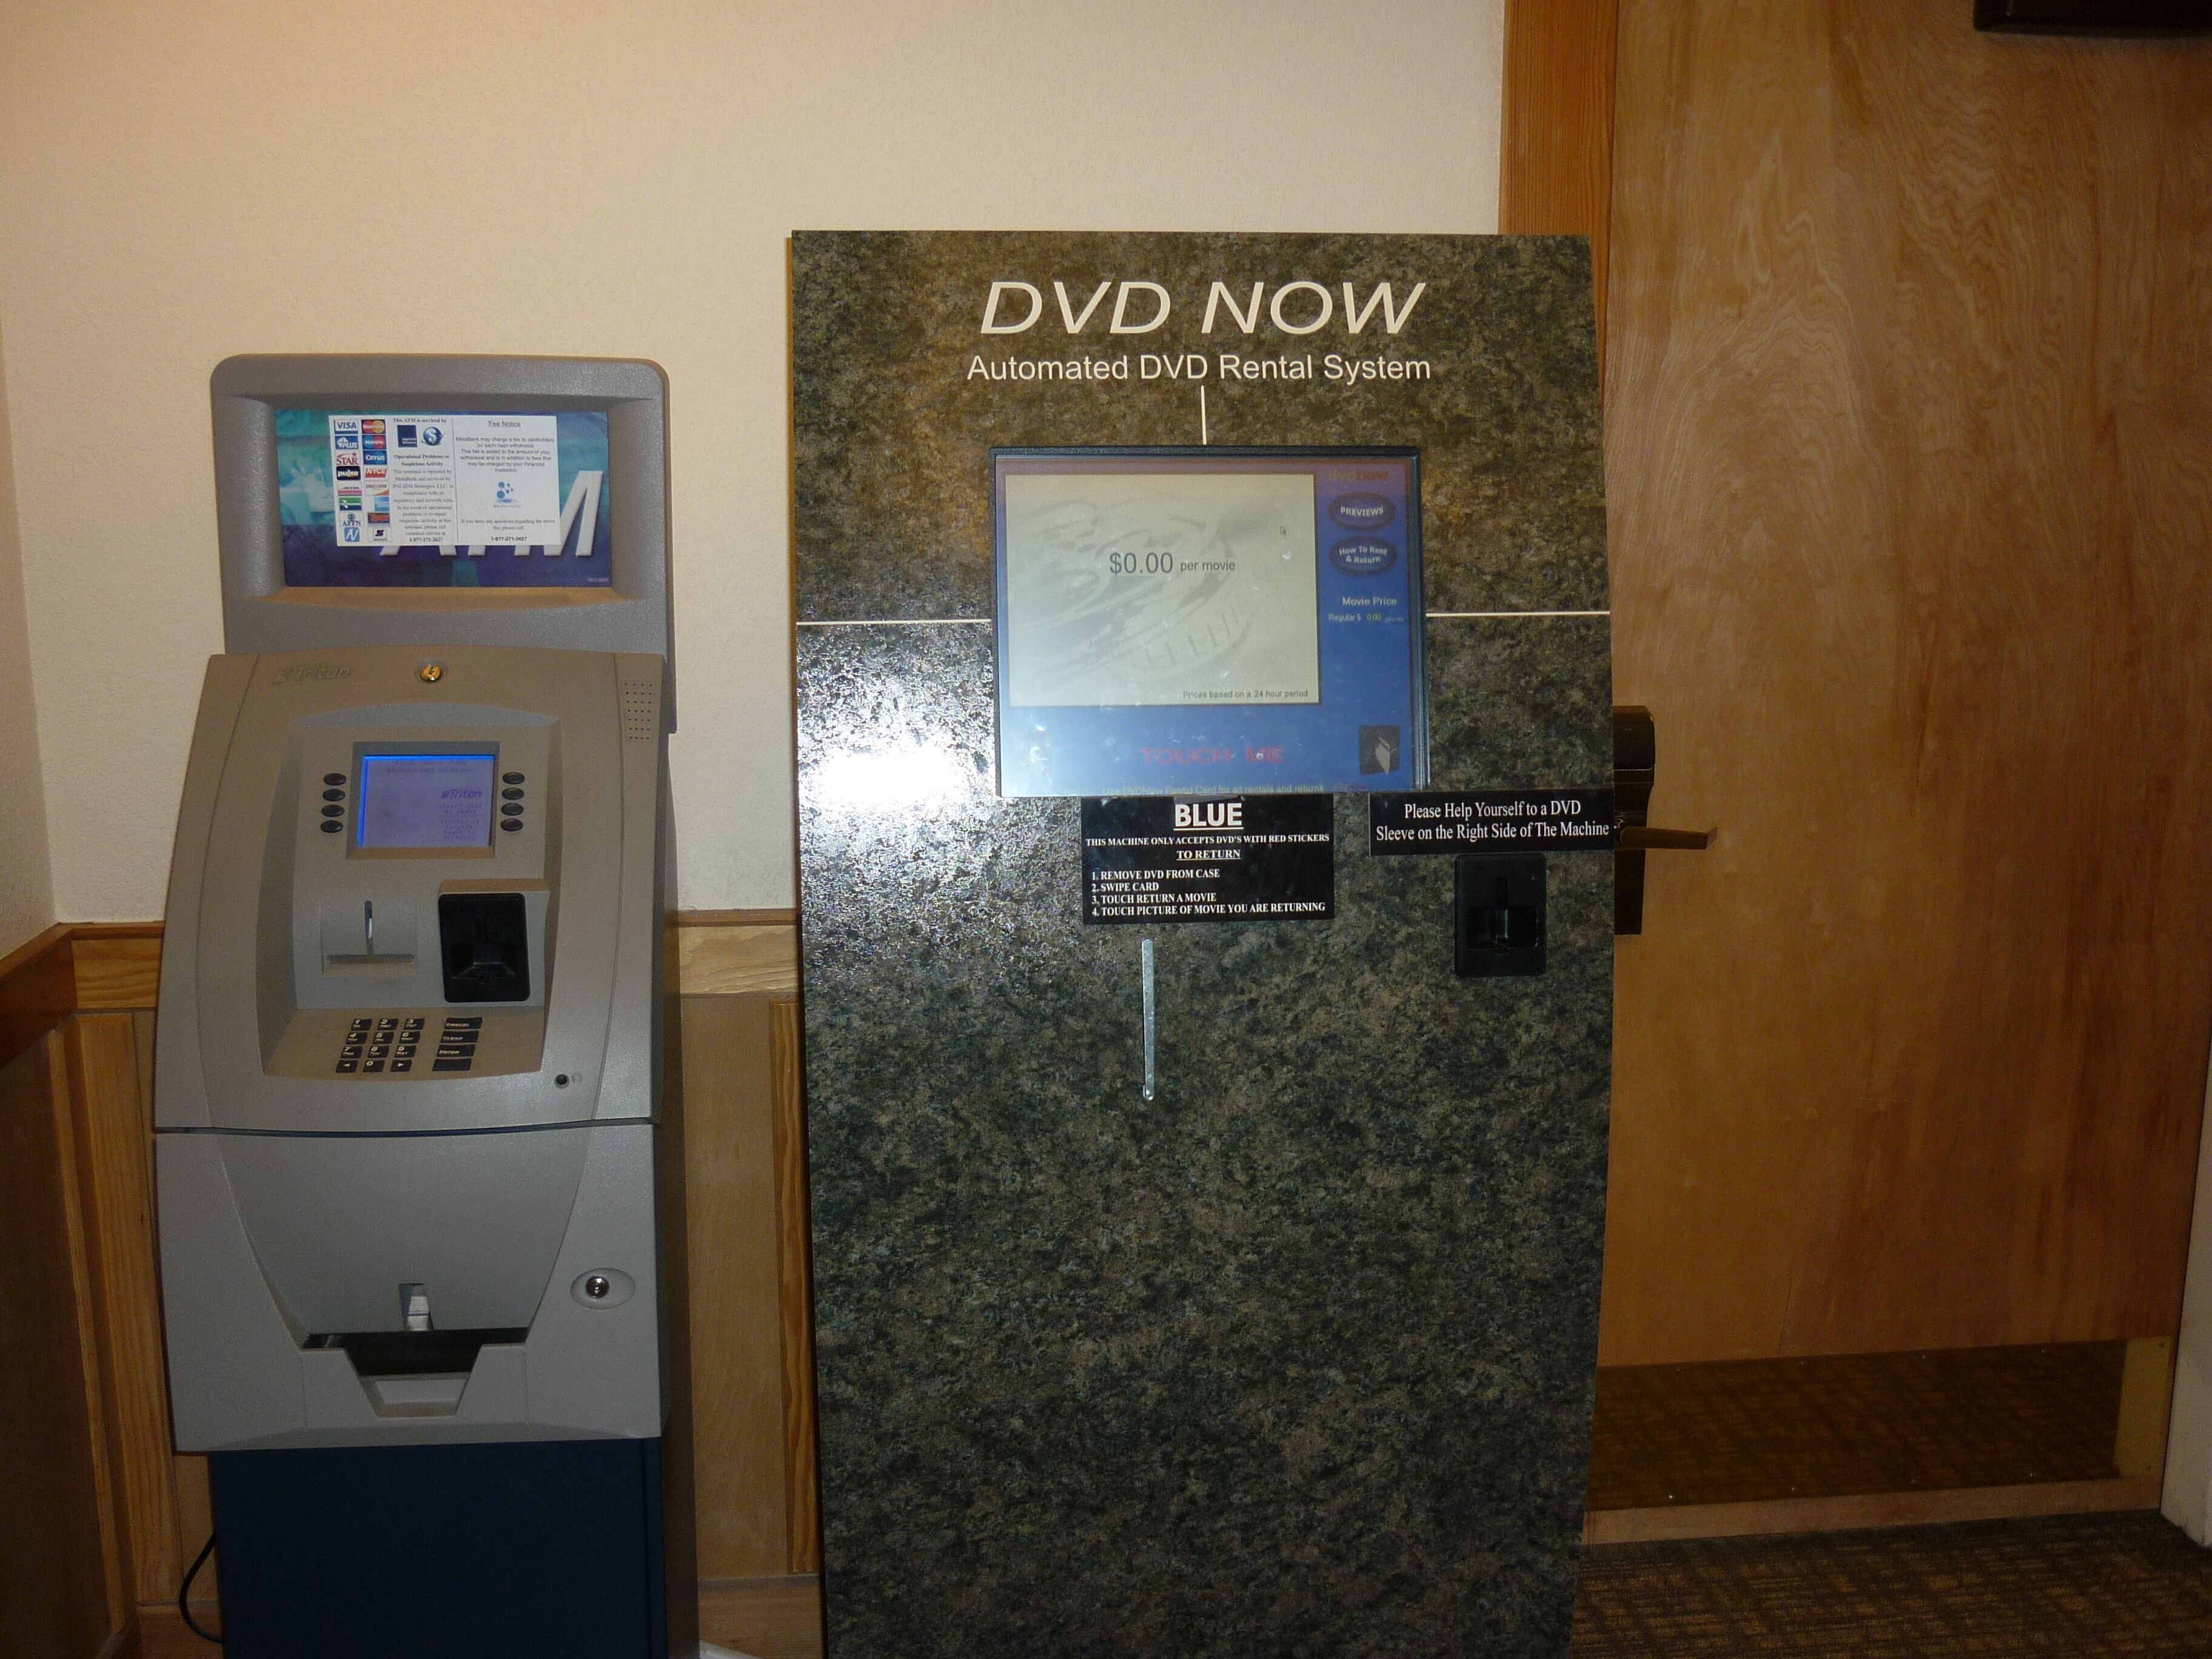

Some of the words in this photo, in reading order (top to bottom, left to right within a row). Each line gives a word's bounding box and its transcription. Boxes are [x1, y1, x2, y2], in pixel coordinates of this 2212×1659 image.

[980, 282, 1171, 335] DVD
[1201, 281, 1426, 335] NOW
[967, 355, 1128, 380] Automated
[1141, 355, 1208, 380] DVD
[1219, 355, 1312, 379] Rental
[1324, 354, 1430, 384] System
[1340, 506, 1384, 517] PREVIEWS
[1370, 547, 1387, 555] Rent
[1109, 552, 1174, 577] $0.00
[1180, 561, 1198, 572] per
[1202, 560, 1236, 571] movie
[1354, 555, 1381, 564] Return
[1342, 597, 1370, 606] Movie
[1373, 597, 1397, 605] Price
[1329, 614, 1356, 622] Regular
[1183, 690, 1207, 699] Prices
[1209, 689, 1233, 698] based
[1265, 689, 1282, 698] hour
[1285, 689, 1308, 699] period
[1140, 748, 1232, 764] TOUCH
[1246, 746, 1284, 763] ME
[450, 789, 482, 799] Triton
[1175, 803, 1242, 827] BLUE
[1404, 803, 1441, 819] Please
[1444, 803, 1472, 820] Help
[1474, 801, 1525, 817] Yourself
[1526, 802, 1537, 816] to
[1541, 805, 1547, 815] a
[1550, 800, 1581, 815] DVD
[1376, 826, 1414, 841] Sleeve
[1418, 828, 1433, 840] on
[1435, 825, 1453, 839] the
[1456, 824, 1488, 842] Right
[1491, 823, 1517, 838] Side
[1520, 822, 1533, 837] of
[1535, 822, 1557, 837] The
[1560, 820, 1609, 836] Machine
[1177, 851, 1192, 859] TO
[1195, 850, 1241, 859] RETURN
[1091, 871, 1099, 880] 1.
[1101, 871, 1142, 880] REMOVE
[1144, 870, 1164, 879] DVD
[1166, 870, 1194, 878] FROM
[1195, 869, 1220, 878] CASE
[1101, 883, 1131, 892] SWIPE
[1132, 883, 1159, 891] CARD
[1092, 896, 1099, 904] 3.
[1101, 896, 1134, 904] TOUCH
[1136, 894, 1175, 903] RETURN
[1185, 893, 1216, 902] MOVIE
[1092, 908, 1099, 916] 4.
[1101, 907, 1134, 916] TOUCH
[1137, 906, 1178, 916] PICTURE
[1179, 906, 1191, 914] OF
[1194, 905, 1225, 914] MOVIE
[1227, 905, 1248, 913] YOU
[1249, 904, 1269, 913] ARE
[1271, 902, 1326, 912] RETURNING
